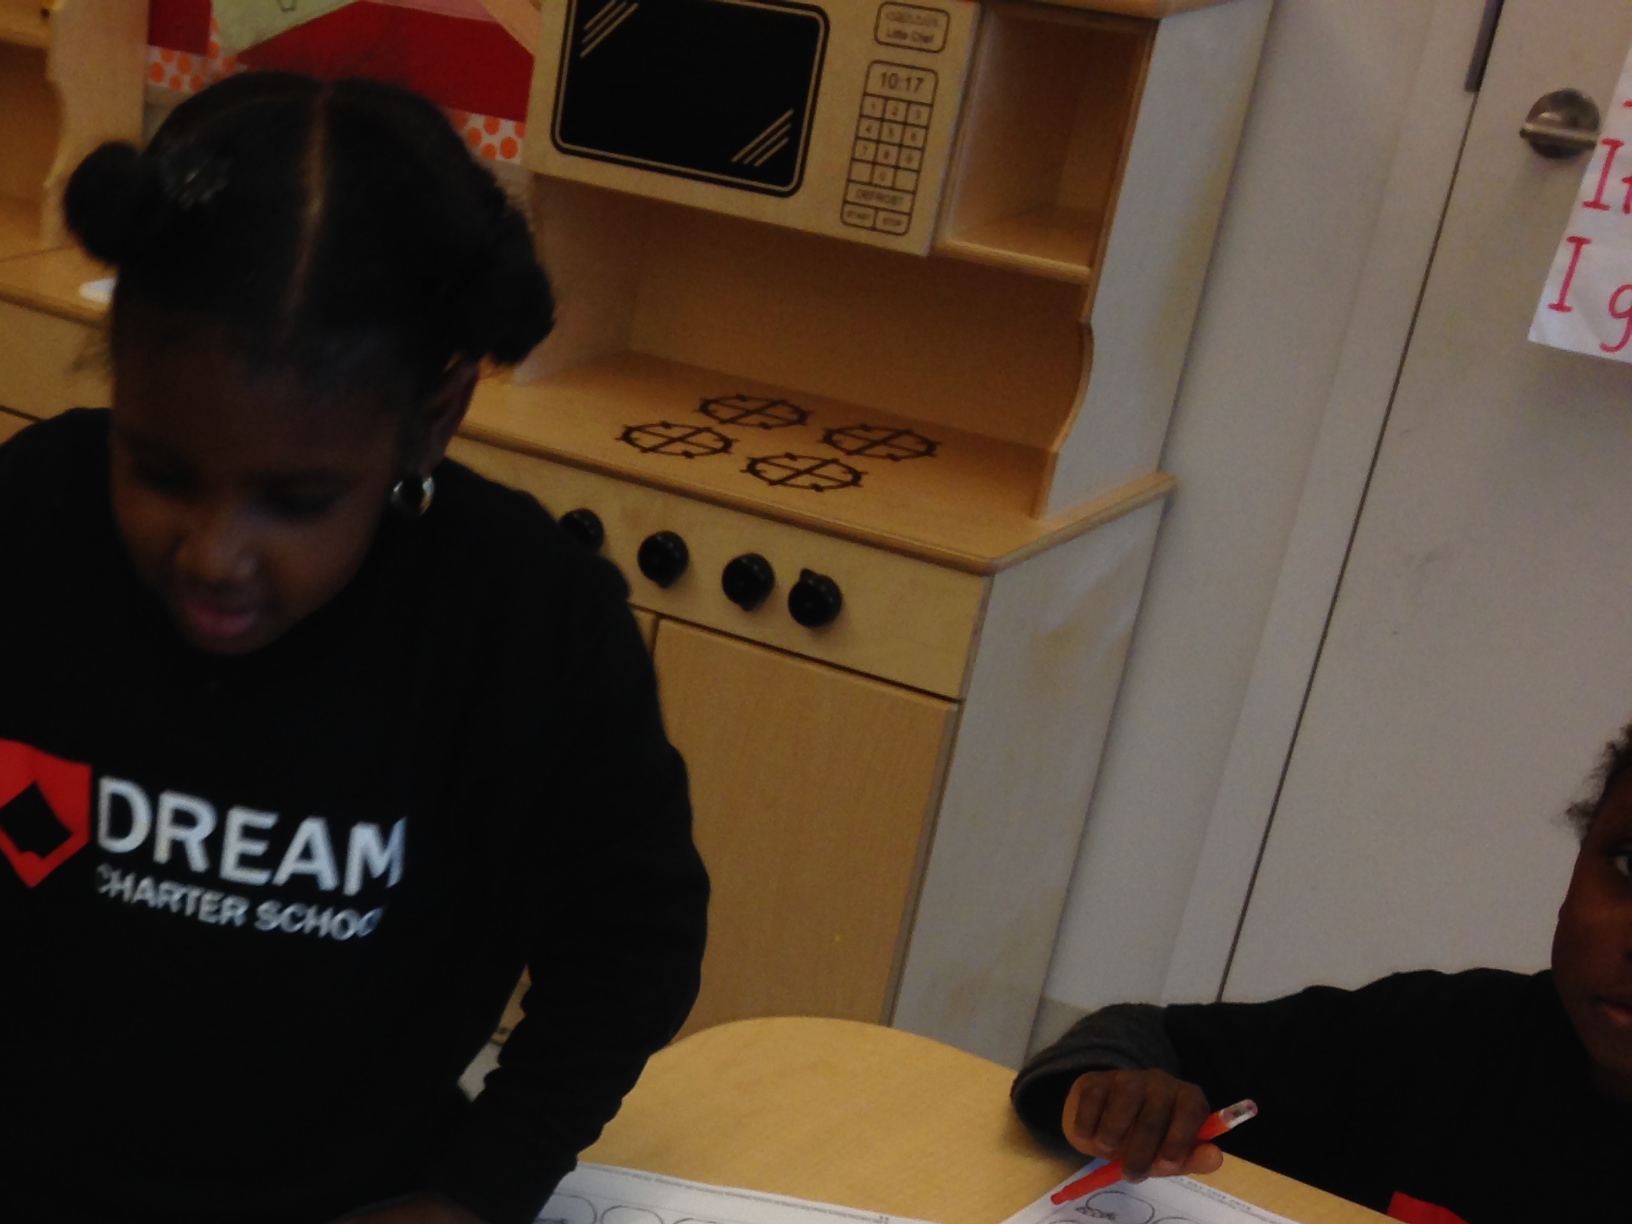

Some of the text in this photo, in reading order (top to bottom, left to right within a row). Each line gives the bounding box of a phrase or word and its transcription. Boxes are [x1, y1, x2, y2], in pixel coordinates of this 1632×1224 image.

[1547, 236, 1632, 353] I g
[97, 774, 408, 896] DREAM
[96, 862, 385, 942] CHARTER SCHOO
